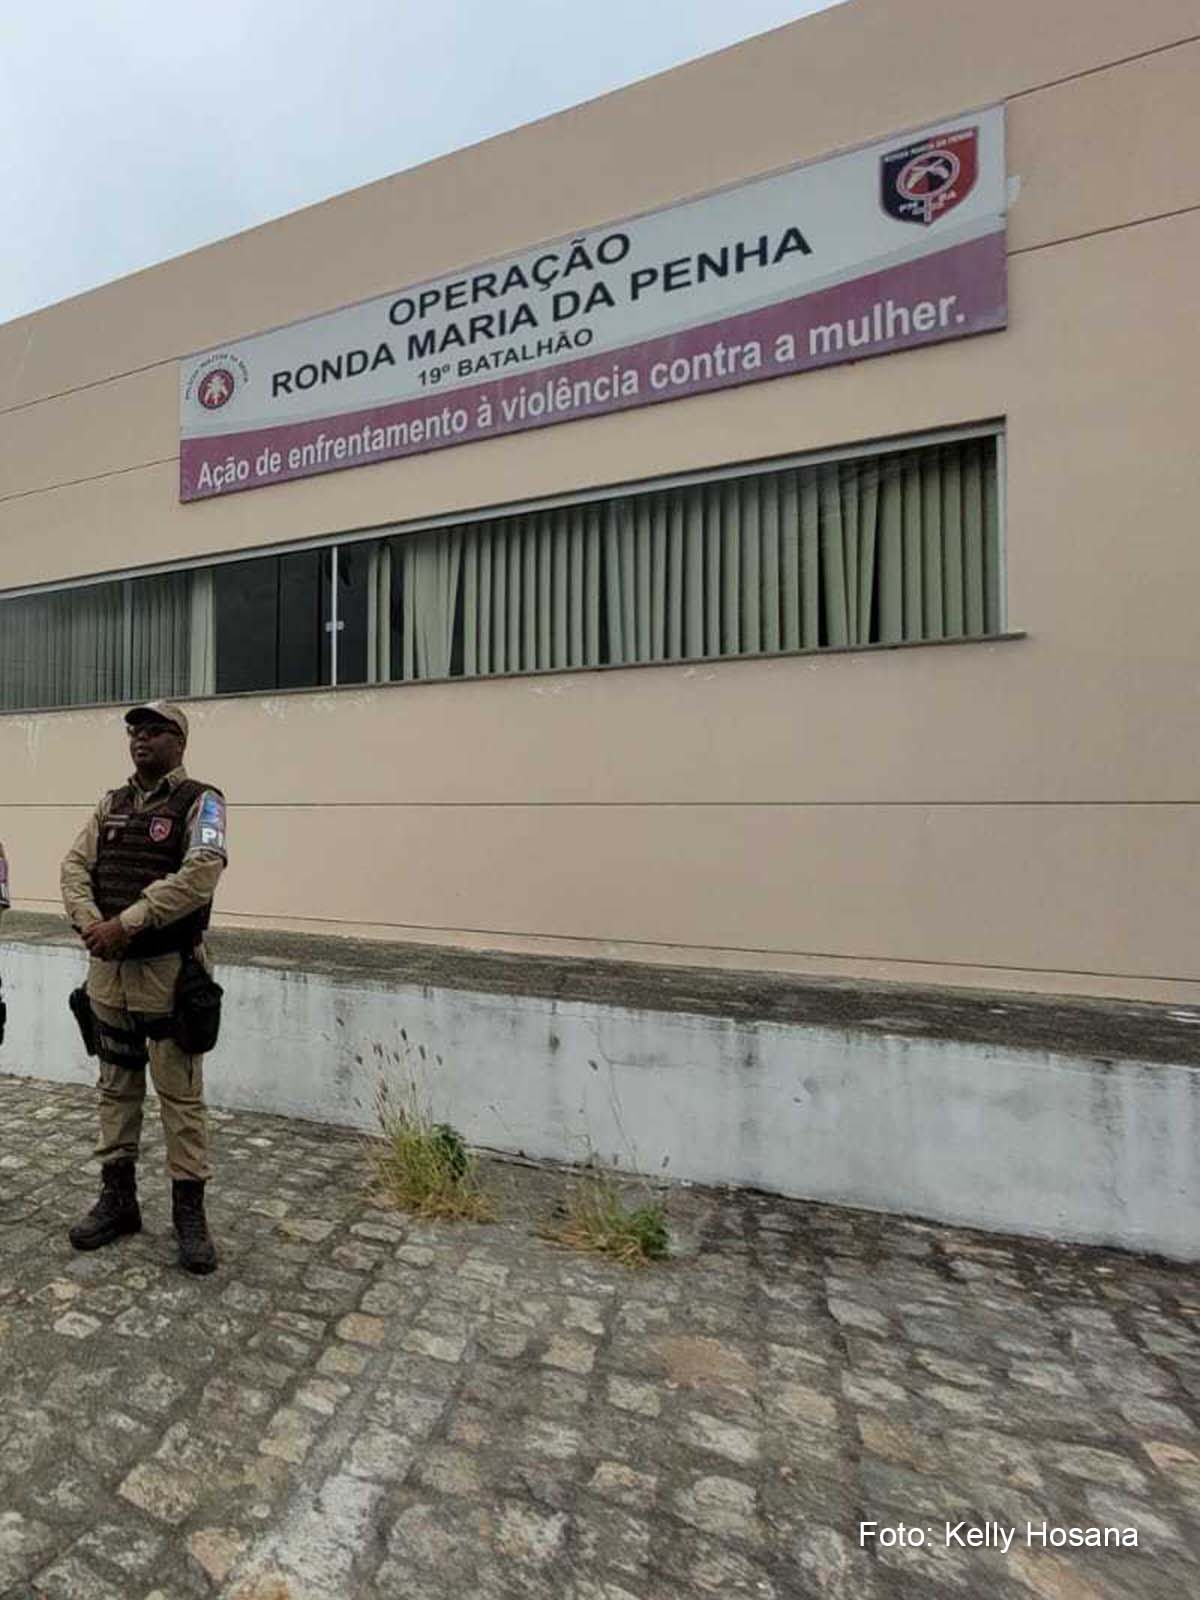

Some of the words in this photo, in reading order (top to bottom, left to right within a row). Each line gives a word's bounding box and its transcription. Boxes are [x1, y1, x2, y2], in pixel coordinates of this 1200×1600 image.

[271, 342, 395, 397] RONDA
[407, 303, 538, 360] MARIA
[552, 281, 615, 321] DA
[630, 227, 812, 300] PENHA
[389, 233, 630, 325] OPERAÇÃO
[197, 457, 249, 490] Ação
[256, 448, 282, 476] de
[288, 408, 468, 469] enfrentamento
[477, 396, 492, 428] à
[502, 365, 638, 422] violência
[650, 341, 762, 390] contra
[775, 334, 795, 362] a
[810, 295, 965, 356] mulher.
[457, 328, 593, 377] BATALHÃO
